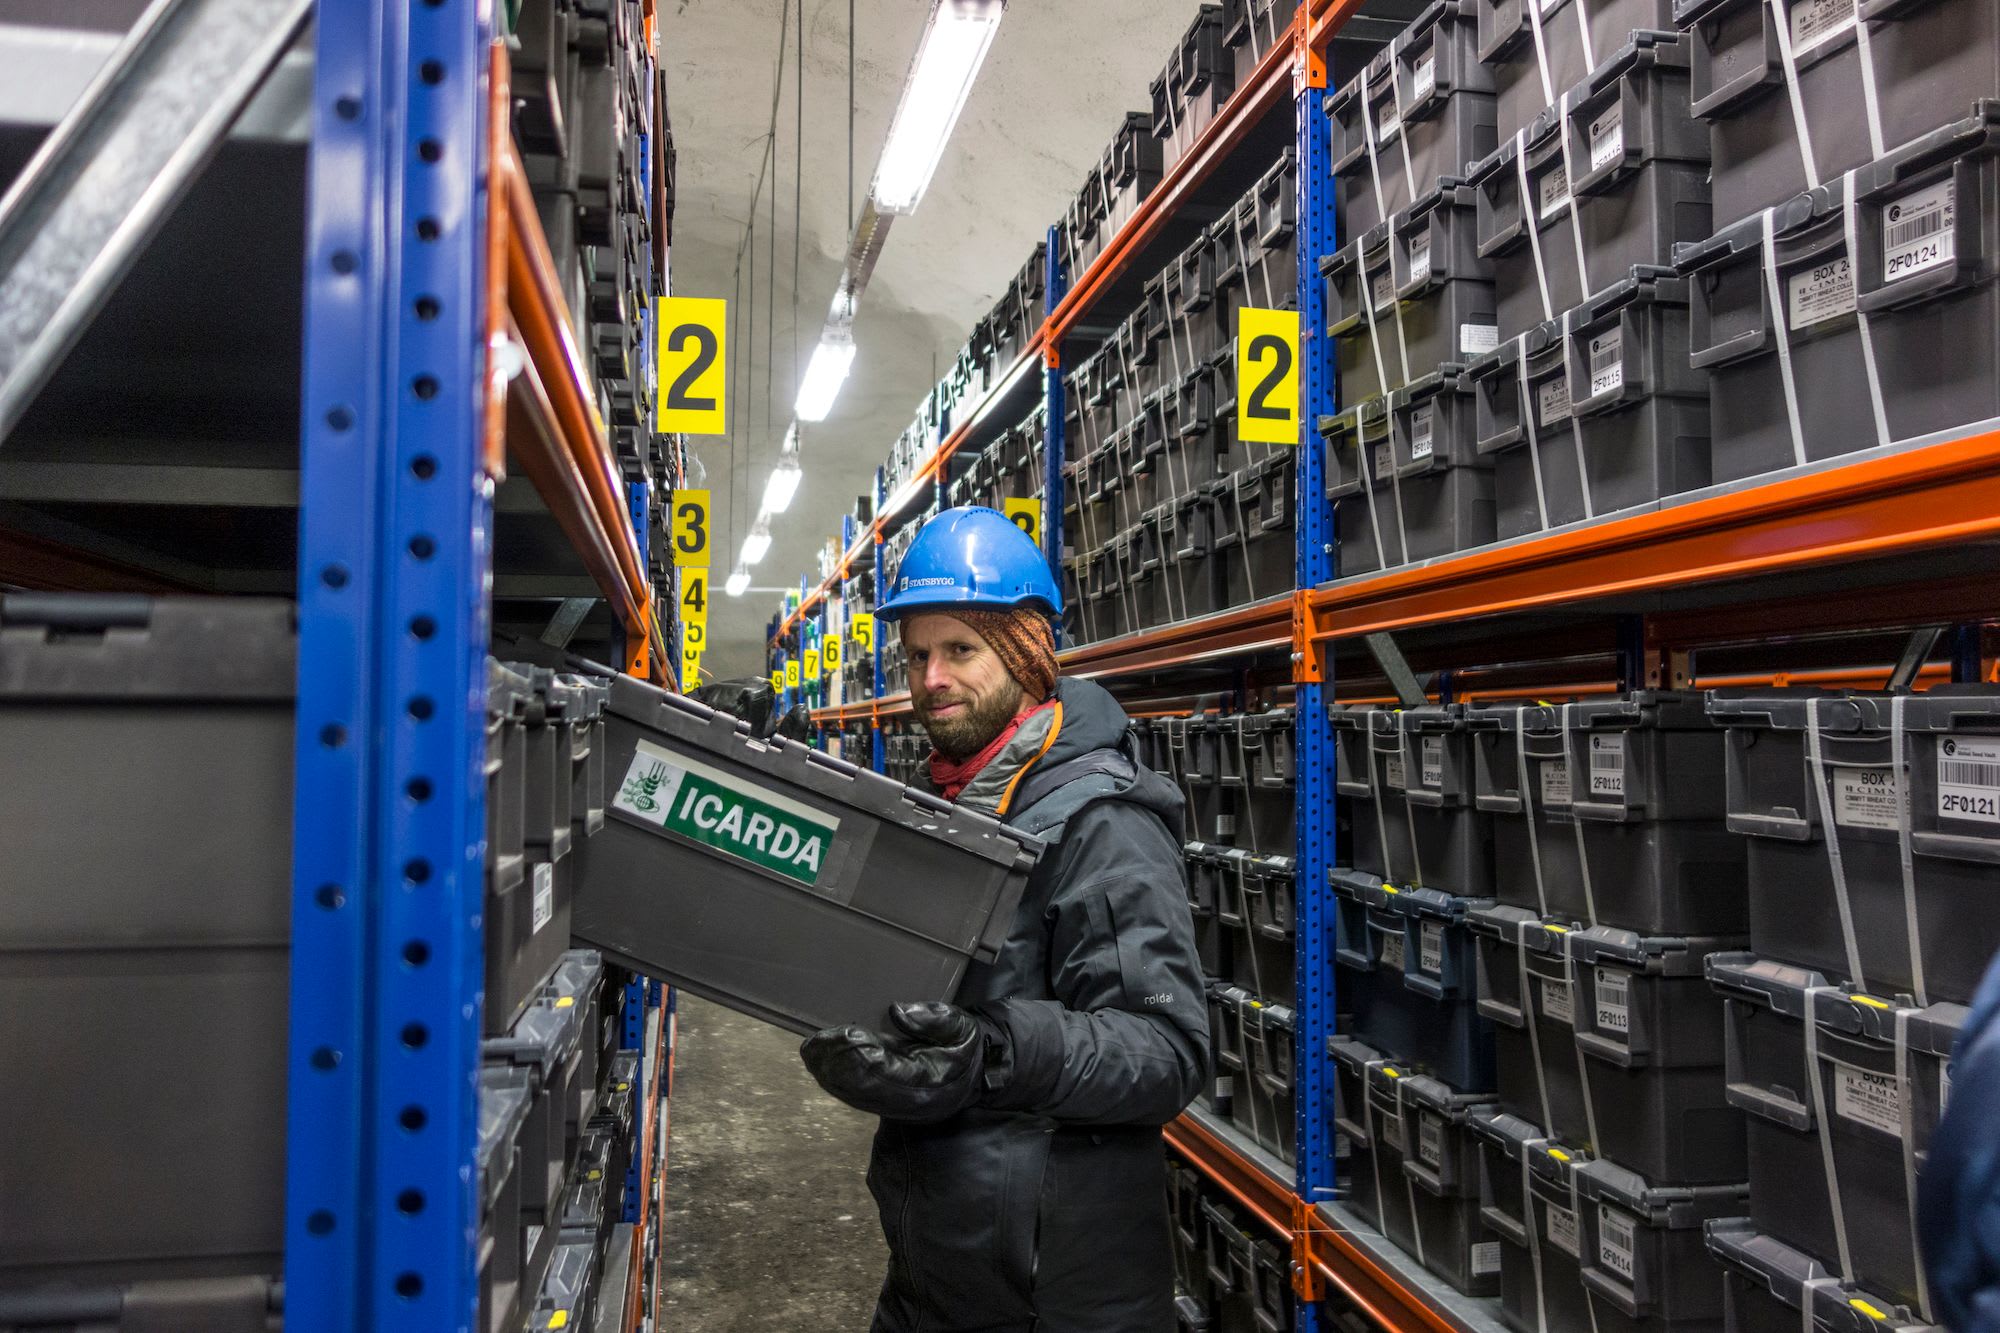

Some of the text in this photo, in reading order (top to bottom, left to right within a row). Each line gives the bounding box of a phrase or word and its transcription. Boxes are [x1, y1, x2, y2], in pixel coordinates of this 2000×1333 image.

[1888, 243, 1937, 274] 2F0124
[1813, 263, 1835, 281] BOX
[666, 323, 718, 411] 2
[1247, 334, 1292, 420] 2
[1593, 370, 1620, 392] 2F0115
[677, 502, 706, 553] 3
[909, 577, 955, 588] STATSBYGG
[684, 578, 705, 612] 4
[856, 622, 870, 647] 5
[826, 640, 838, 662] 6
[788, 666, 798, 682] 8
[807, 656, 817, 673] 7
[774, 675, 783, 689] 9
[1593, 776, 1621, 791] 2F0112
[1861, 772, 1885, 786] BOX
[1941, 794, 1996, 816] 2F0121
[679, 787, 822, 873] ICARDA
[1599, 1010, 1628, 1028] 2F0113
[1602, 1246, 1631, 1274] 2F0114
